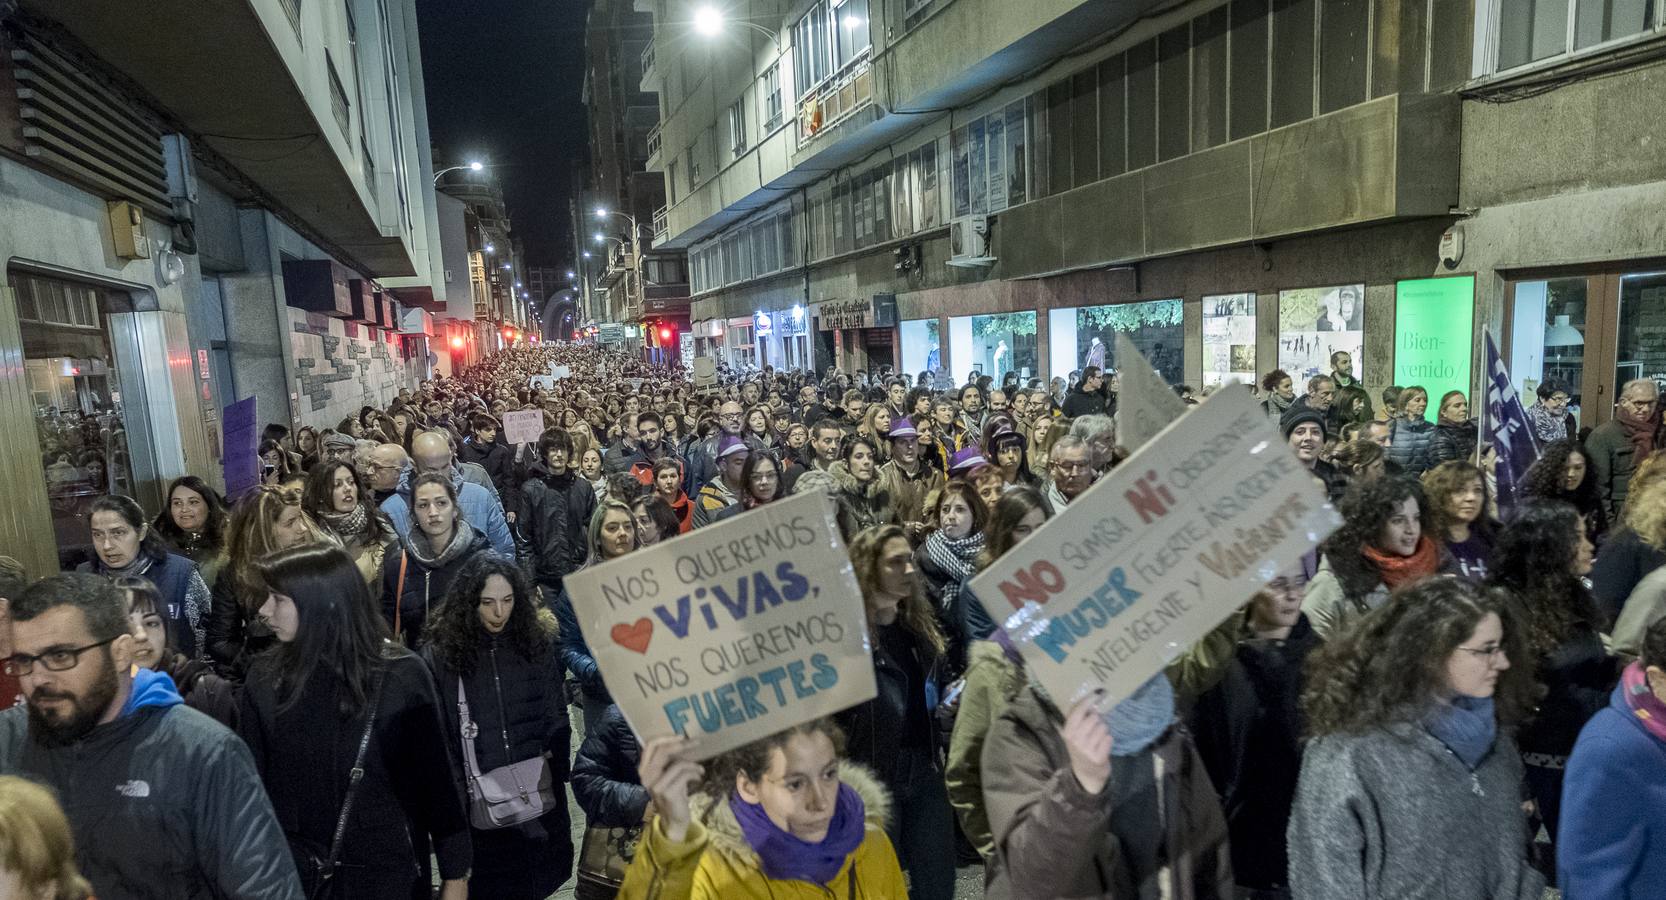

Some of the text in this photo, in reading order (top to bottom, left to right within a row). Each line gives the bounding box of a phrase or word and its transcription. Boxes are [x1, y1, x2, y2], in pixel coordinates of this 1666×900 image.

[1403, 331, 1447, 350] Bien-
[601, 516, 816, 610] NOS QUEREMOS
[998, 559, 1067, 609] NO
[1123, 469, 1176, 525] Ni
[633, 611, 844, 699] NOS QUEREMOS
[1032, 565, 1144, 664] MUJER
[662, 653, 839, 739] FUERTES
